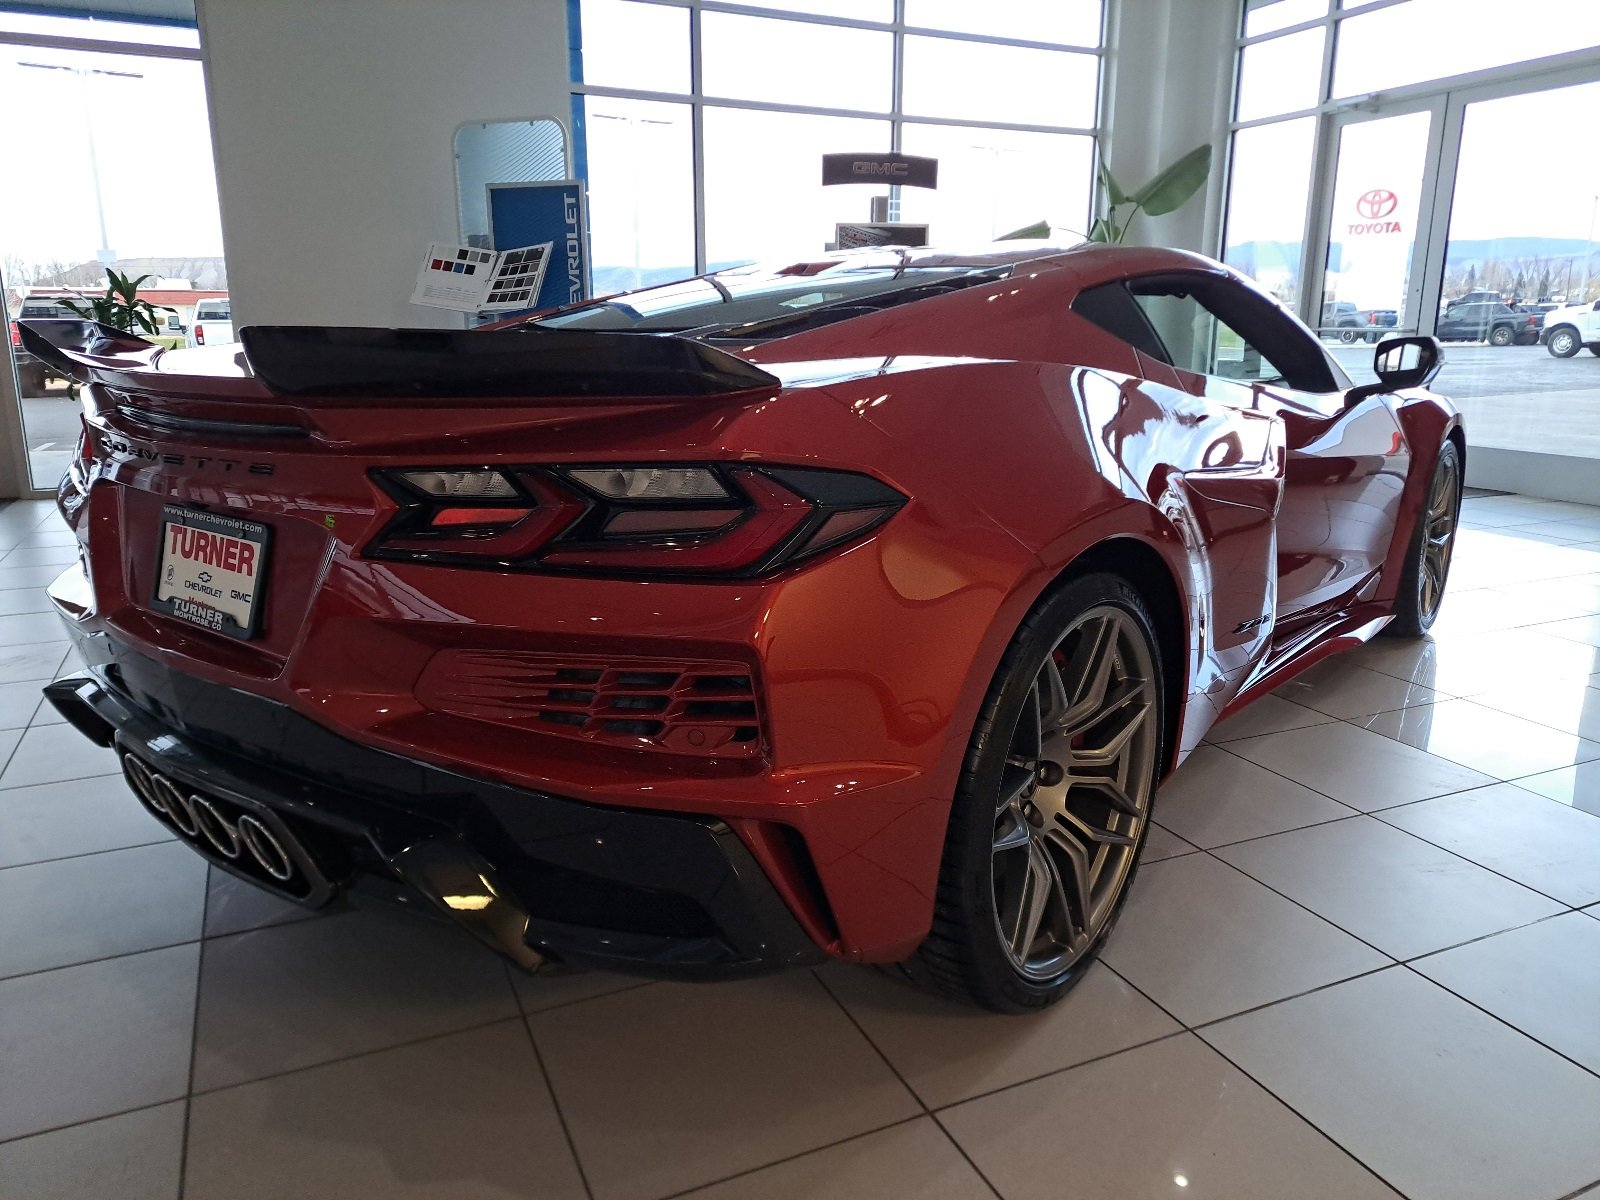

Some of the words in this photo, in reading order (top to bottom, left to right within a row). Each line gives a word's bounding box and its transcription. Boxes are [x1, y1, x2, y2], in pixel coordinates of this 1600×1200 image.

[852, 161, 909, 176] GMC
[1347, 221, 1402, 236] TOYOTA
[101, 437, 276, 475] CORVETTE
[163, 506, 263, 534] www.turnerchevrolet.com
[169, 524, 256, 577] TURNER
[184, 580, 223, 599] CHEVROLET
[230, 589, 252, 604] GMC
[173, 598, 224, 625] TURNER
[173, 609, 210, 628] MONTROSE,
[211, 622, 223, 632] CO
